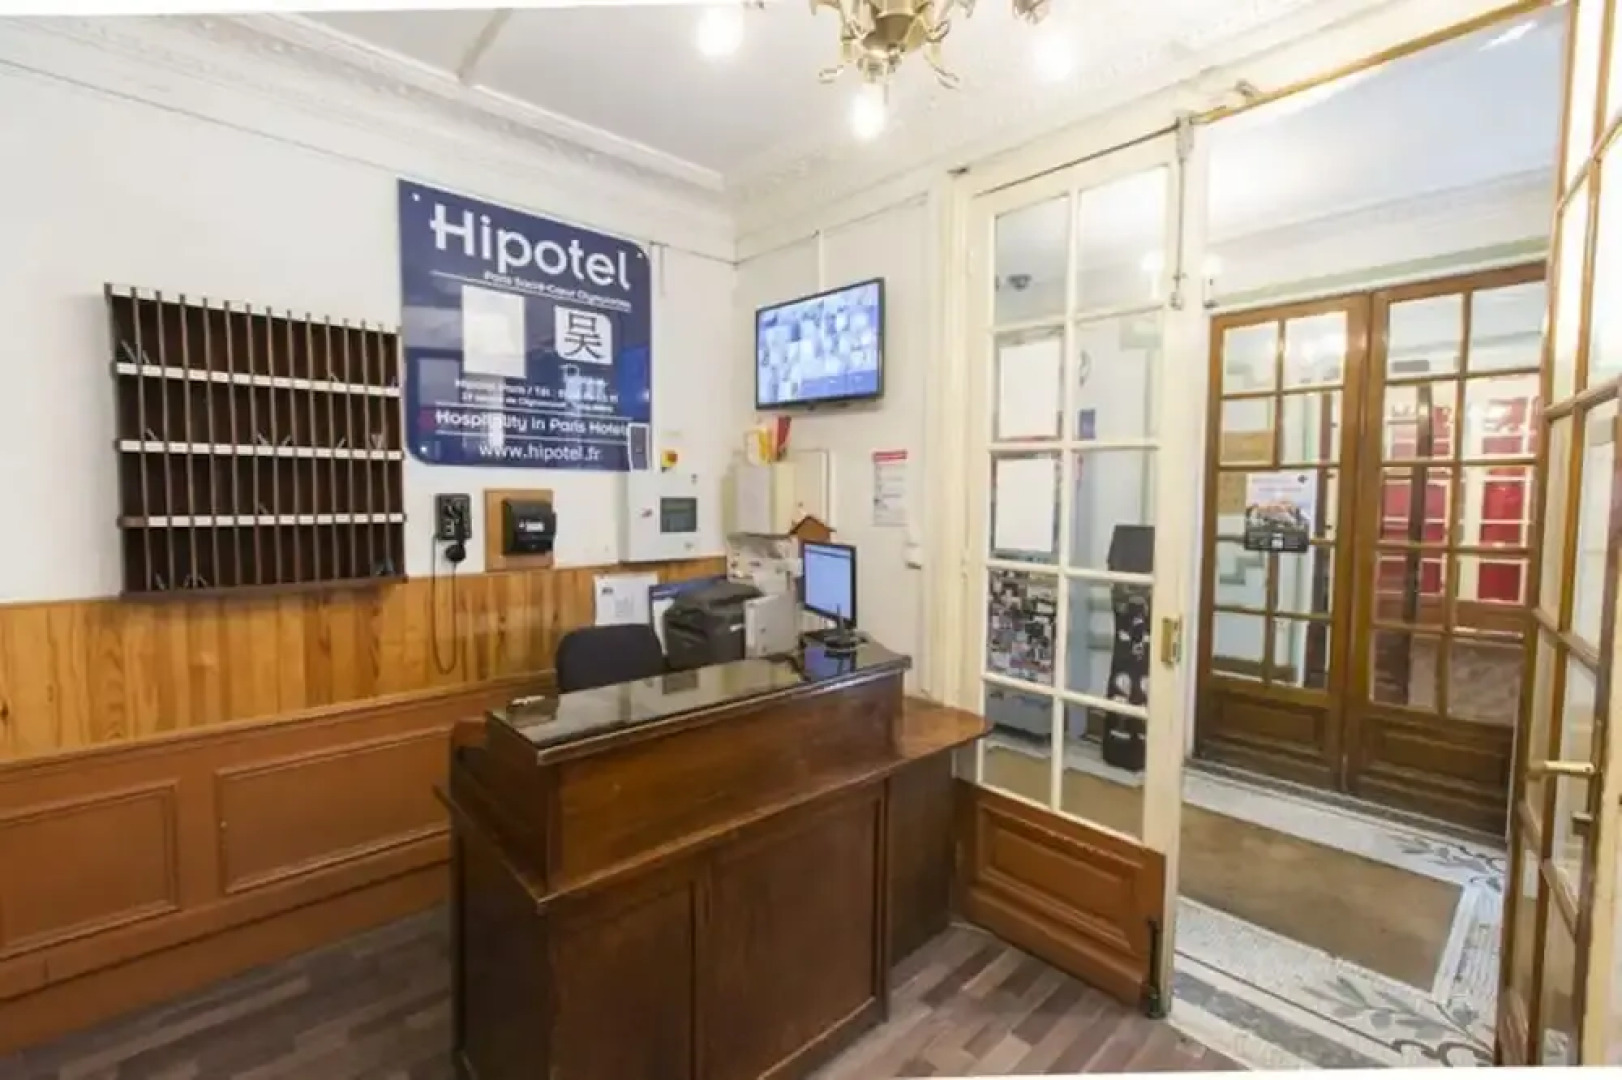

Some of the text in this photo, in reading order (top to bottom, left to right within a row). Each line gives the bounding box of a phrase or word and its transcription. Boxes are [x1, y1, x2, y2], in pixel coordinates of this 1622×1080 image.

[429, 203, 630, 291] Hipotel
[435, 409, 527, 433] Hospility
[549, 417, 586, 434] Paris
[479, 443, 600, 462] www.hipotel.fr
